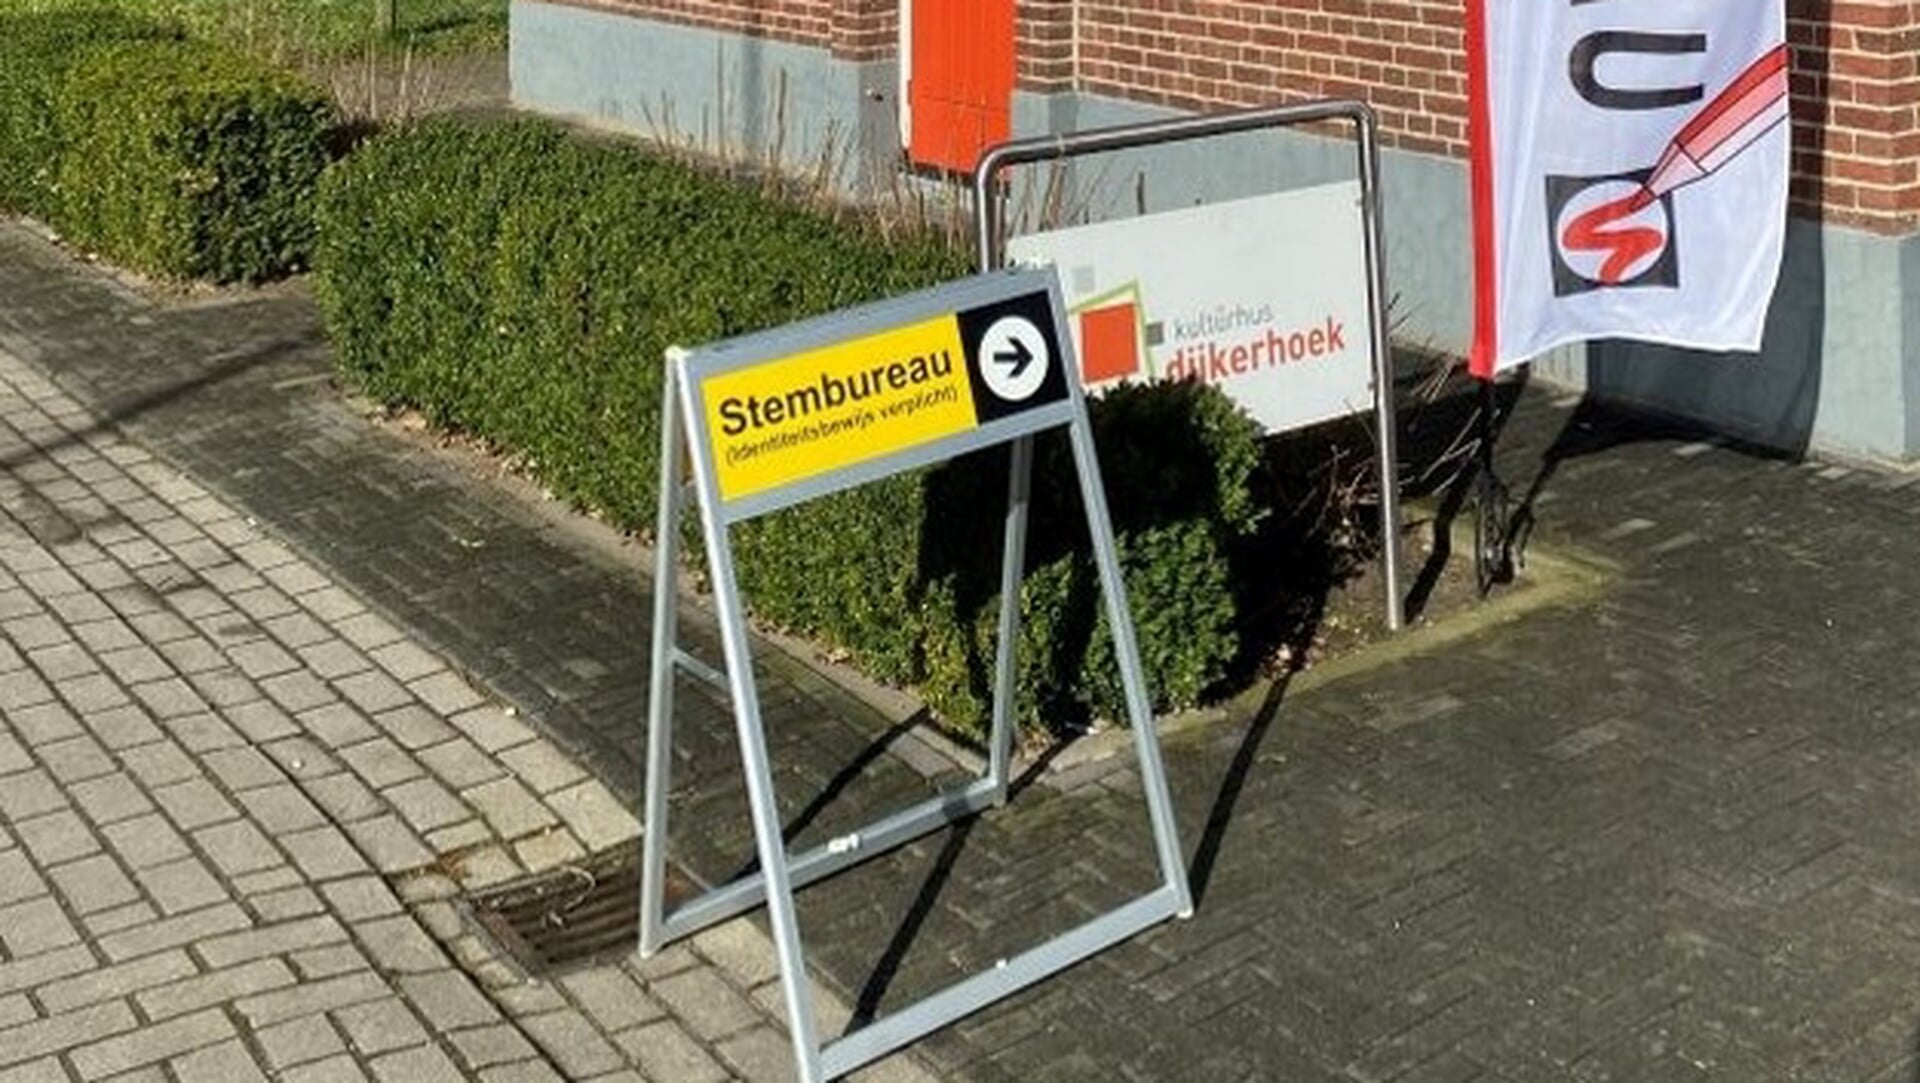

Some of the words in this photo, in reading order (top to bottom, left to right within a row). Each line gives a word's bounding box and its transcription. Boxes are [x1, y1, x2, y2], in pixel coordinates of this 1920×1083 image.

[1569, 0, 1707, 111] U
[718, 349, 953, 437] Stembureau
[1166, 315, 1345, 386] dijkerhoek
